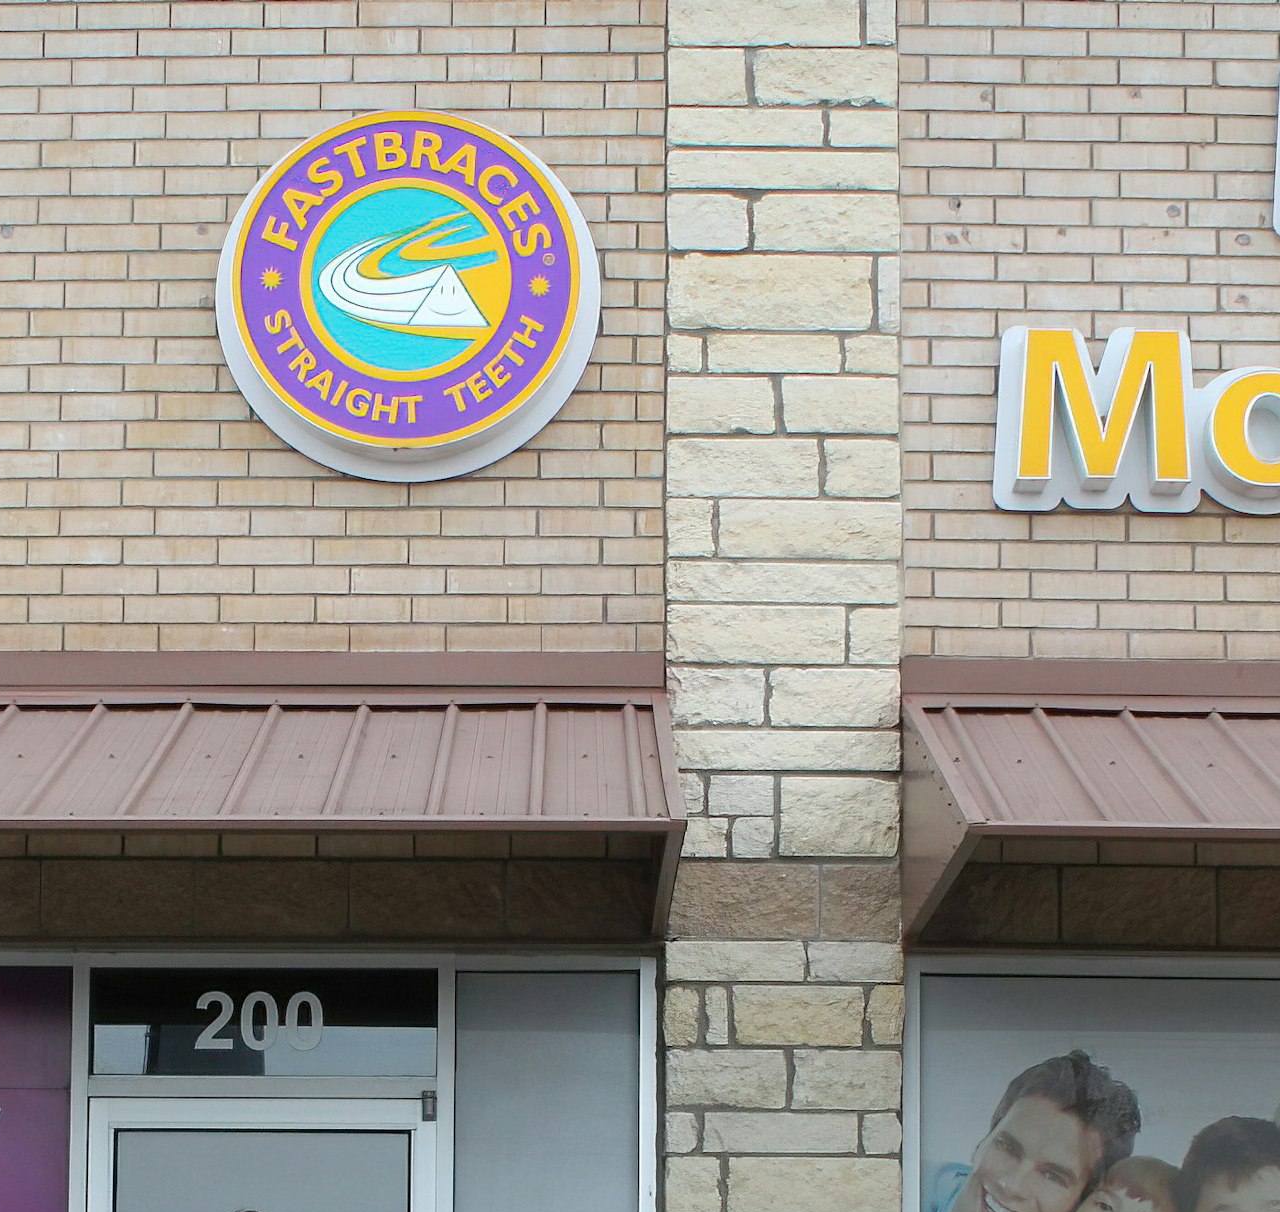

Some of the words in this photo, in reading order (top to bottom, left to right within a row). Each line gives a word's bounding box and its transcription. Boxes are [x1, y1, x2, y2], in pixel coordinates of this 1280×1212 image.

[261, 130, 552, 258] FASTBRACES
[263, 308, 423, 425] STRAIGHT
[443, 314, 546, 414] TEETH
[194, 990, 325, 1052] 200
